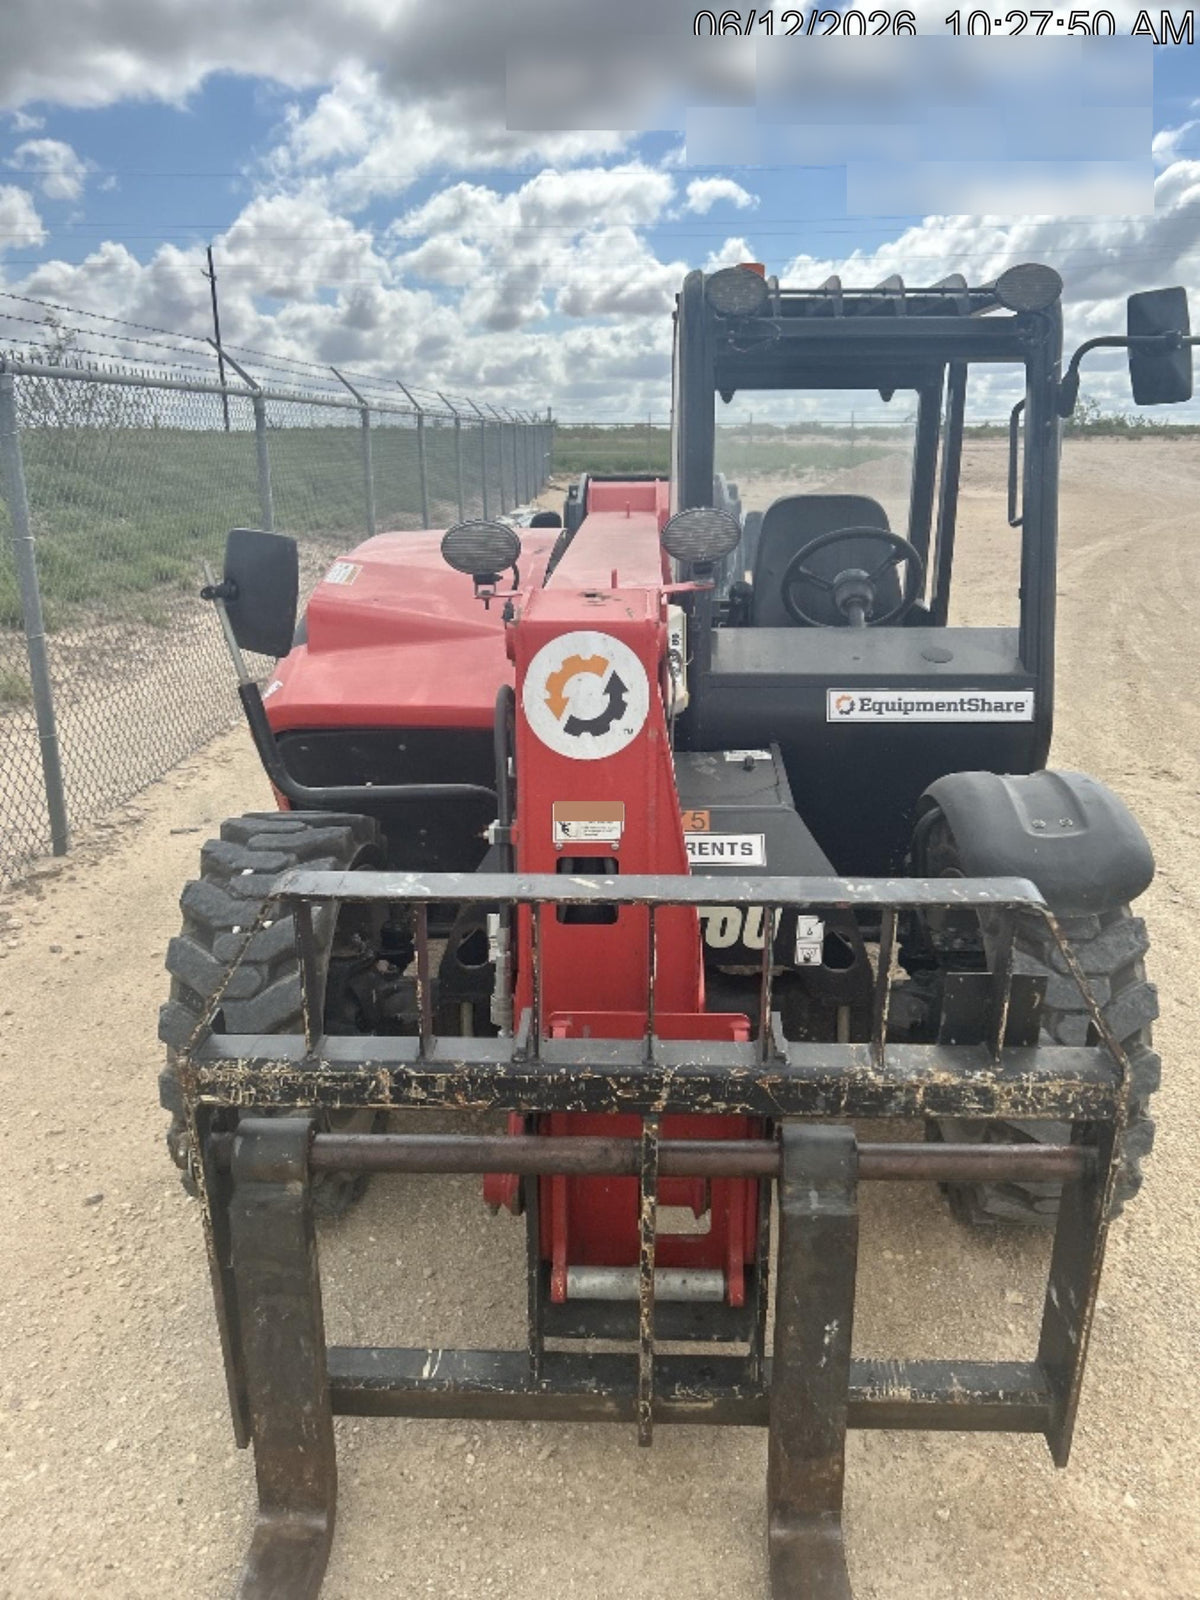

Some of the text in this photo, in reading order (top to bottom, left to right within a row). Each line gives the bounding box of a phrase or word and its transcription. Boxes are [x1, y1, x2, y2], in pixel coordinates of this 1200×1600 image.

[859, 697, 1025, 715] EquipmentShare
[686, 811, 705, 830] 5
[685, 841, 753, 856] RENTS
